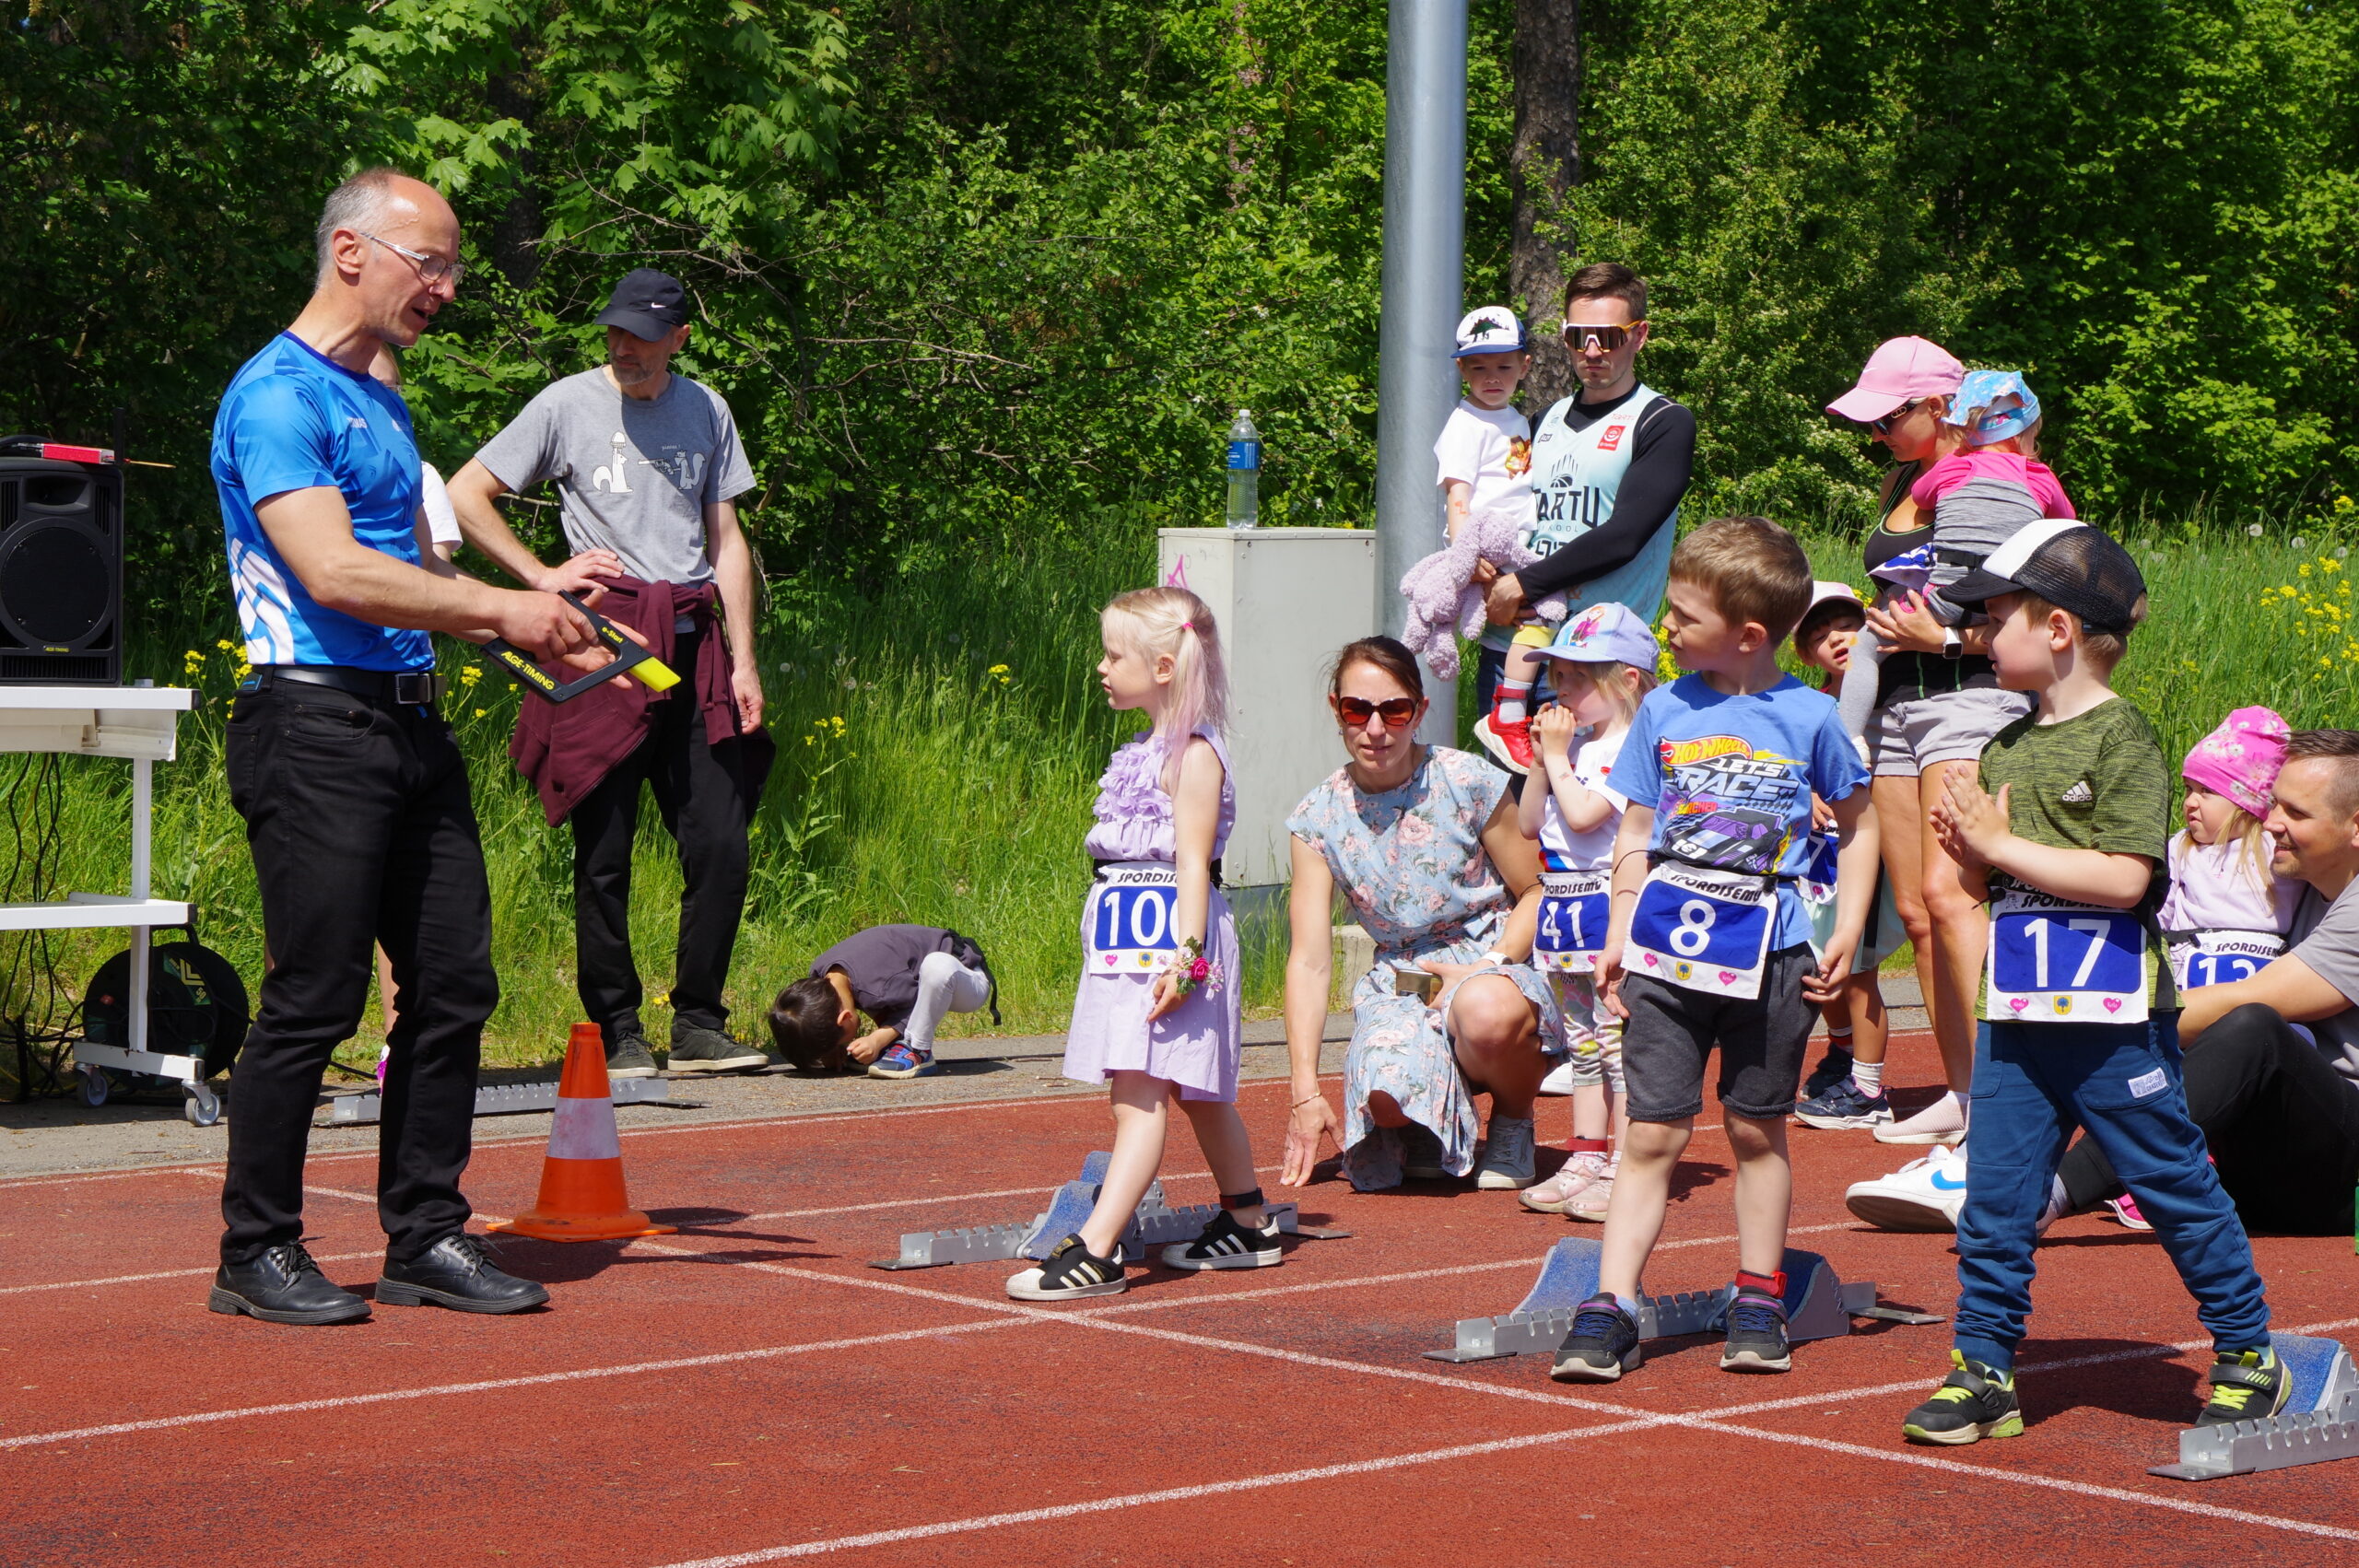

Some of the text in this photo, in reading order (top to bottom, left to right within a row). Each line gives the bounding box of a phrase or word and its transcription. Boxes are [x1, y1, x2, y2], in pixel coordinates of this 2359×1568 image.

[501, 650, 555, 690] ALGE-TIMING
[1672, 743, 1702, 766] HOT
[1704, 757, 1785, 778] LET'S
[1672, 767, 1800, 802] RACE
[1118, 872, 1178, 884] SPORDIS
[1542, 901, 1585, 950] 41
[1669, 899, 1717, 957] 8
[2024, 918, 2111, 989] 17
